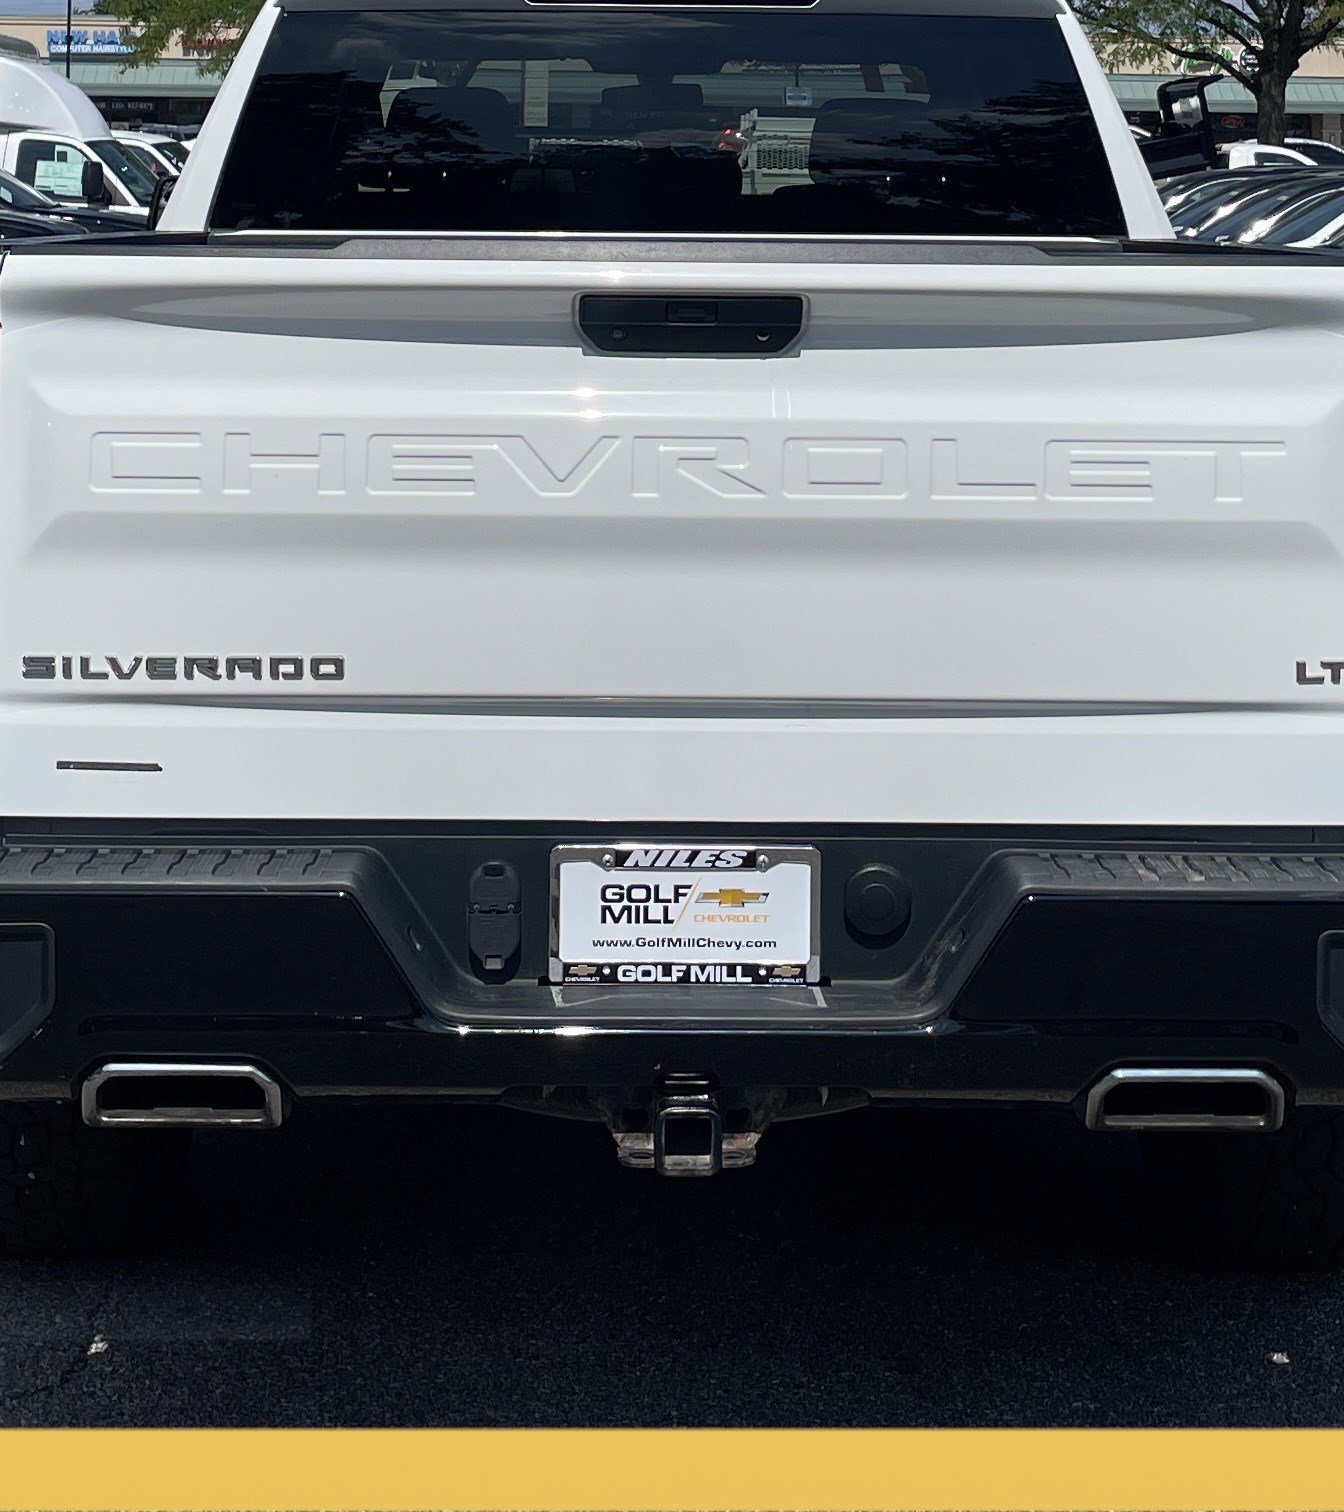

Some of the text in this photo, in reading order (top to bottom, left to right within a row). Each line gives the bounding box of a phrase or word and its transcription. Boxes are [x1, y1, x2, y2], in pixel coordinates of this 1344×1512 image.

[50, 43, 91, 53] COMUTER
[88, 431, 1286, 503] CHEVROLET
[21, 655, 345, 681] SILVERADO
[623, 849, 747, 868] NILES
[600, 884, 693, 904] GOLF
[600, 905, 675, 925] MILL
[693, 914, 770, 924] CHEVROLET
[591, 937, 777, 949] www.GolfMillChevy.com
[617, 964, 753, 984] GOLF MILL
